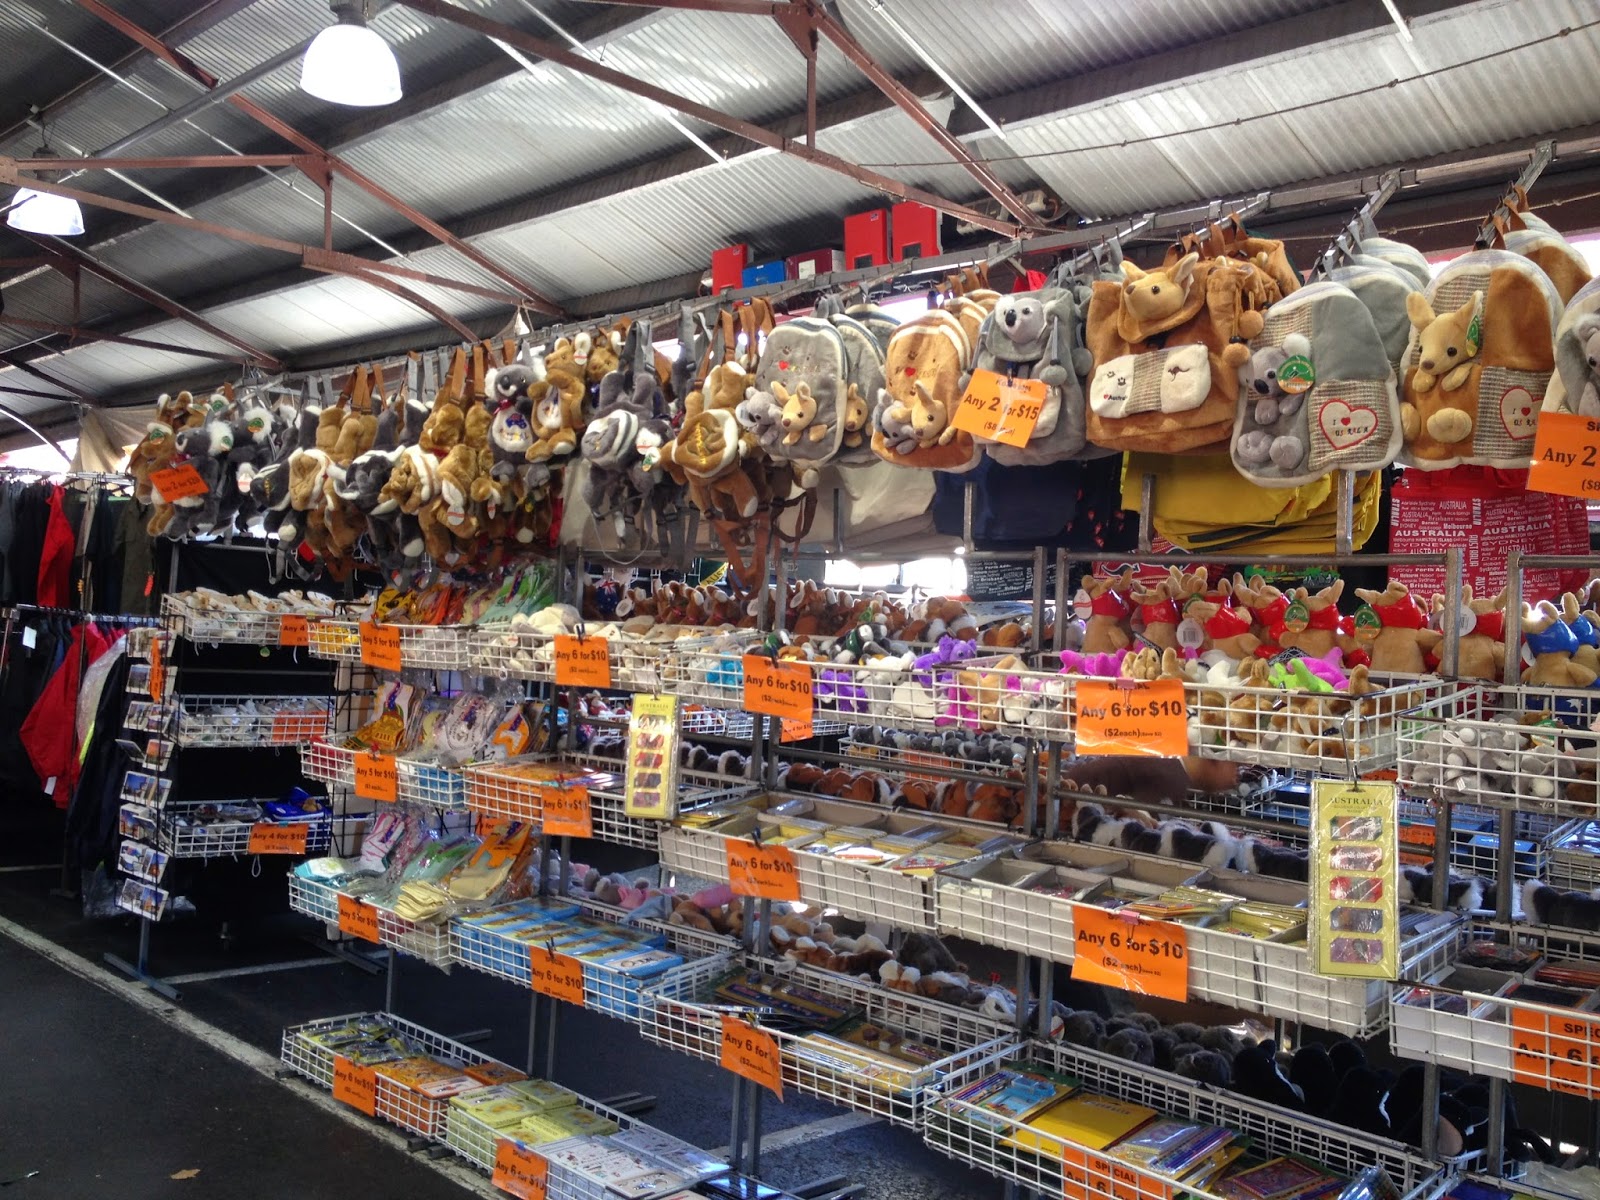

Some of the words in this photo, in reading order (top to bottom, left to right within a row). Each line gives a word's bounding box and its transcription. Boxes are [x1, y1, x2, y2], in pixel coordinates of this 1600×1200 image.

[964, 394, 986, 410] Any
[988, 397, 1001, 412] 2
[1003, 403, 1017, 417] for
[1017, 404, 1040, 420] $15
[1542, 447, 1577, 468] Any
[1582, 446, 1597, 467] 2
[1439, 501, 1467, 510] AUSTRALIA
[1401, 511, 1429, 519] AUSTRALIA
[1483, 522, 1551, 536] AUSTRALIA
[283, 625, 297, 633] Any
[379, 638, 387, 647] for
[557, 651, 570, 662] Any
[572, 650, 577, 660] 6
[580, 651, 590, 660] for
[591, 650, 606, 661] $10
[746, 674, 763, 688] Any
[767, 676, 773, 687] 6
[776, 679, 789, 690] for
[790, 680, 810, 695] $10
[1107, 683, 1151, 692] SPIAL
[1080, 706, 1106, 722] Any
[1111, 702, 1121, 718] 6
[1126, 705, 1146, 718] for
[1149, 699, 1182, 719] $10
[357, 767, 368, 777] Any
[374, 768, 382, 778] for
[384, 770, 395, 780] $10
[557, 799, 562, 809] 6
[1329, 797, 1384, 806] AUSTRALIA
[730, 858, 747, 870] Any
[750, 857, 757, 869] 6
[760, 860, 772, 871] for
[773, 860, 793, 874] $10
[1078, 930, 1105, 948] Any
[1110, 932, 1120, 948] 6
[1127, 938, 1147, 952] for
[1149, 938, 1183, 959] $10
[545, 956, 565, 968] SECIAL
[532, 968, 544, 980] Any
[546, 970, 552, 981] 6
[553, 974, 564, 985] for
[565, 975, 581, 990] $10
[725, 1033, 743, 1049] Any
[746, 1039, 752, 1052] 6
[755, 1046, 768, 1059] for
[1516, 1042, 1557, 1066] Any
[1567, 1048, 1582, 1067] 6
[335, 1070, 347, 1081] Any
[348, 1072, 353, 1082] 6
[362, 1079, 374, 1092] $10
[496, 1160, 509, 1175] Any
[510, 1164, 516, 1176] 6
[518, 1170, 528, 1182] for
[529, 1174, 545, 1191] $10
[1095, 1160, 1136, 1184] SPECIAL
[1096, 1181, 1107, 1197] 6
